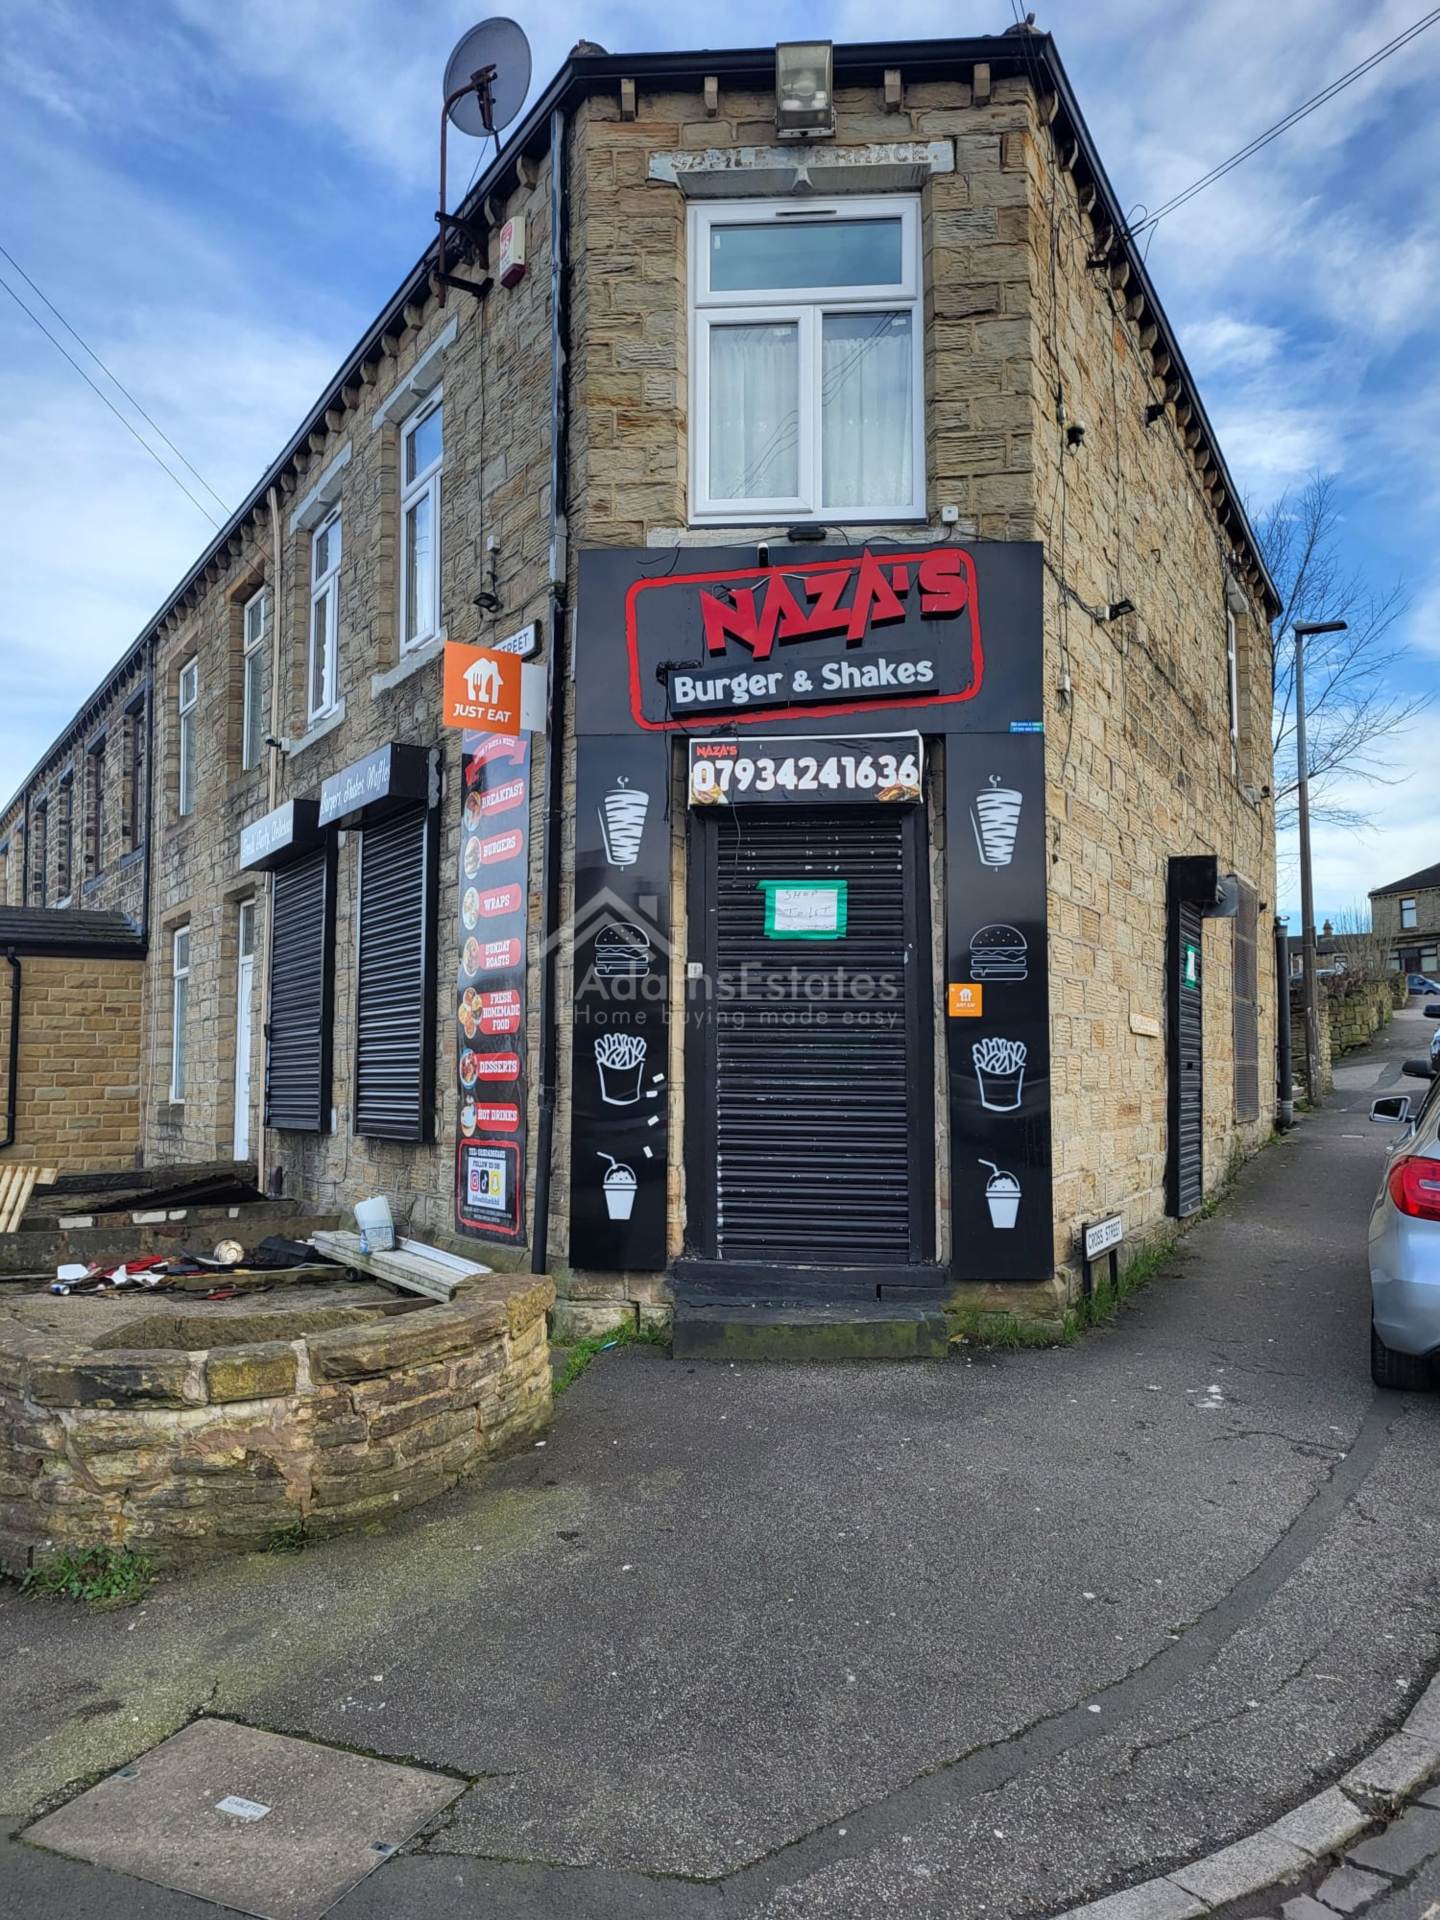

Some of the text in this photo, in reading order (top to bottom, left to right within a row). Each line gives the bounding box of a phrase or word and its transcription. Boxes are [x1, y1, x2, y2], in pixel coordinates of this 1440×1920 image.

[699, 547, 969, 661] NAZA'S
[674, 658, 934, 704] Burger & Shakes
[453, 703, 512, 723] JUST EAT
[696, 743, 737, 758] NAZA'S
[692, 754, 919, 791] 07934241636
[481, 781, 524, 809] BREAKFAST
[483, 836, 516, 857] BURGERS
[484, 894, 510, 912] WRAPS
[486, 954, 510, 969] ROASTS
[490, 991, 512, 1005] FRESH
[482, 1004, 520, 1018] HOMEMADE
[492, 1018, 510, 1032] FOOD
[479, 1060, 518, 1074] DESSERTS
[1088, 1219, 1120, 1250] CROSS STREET
